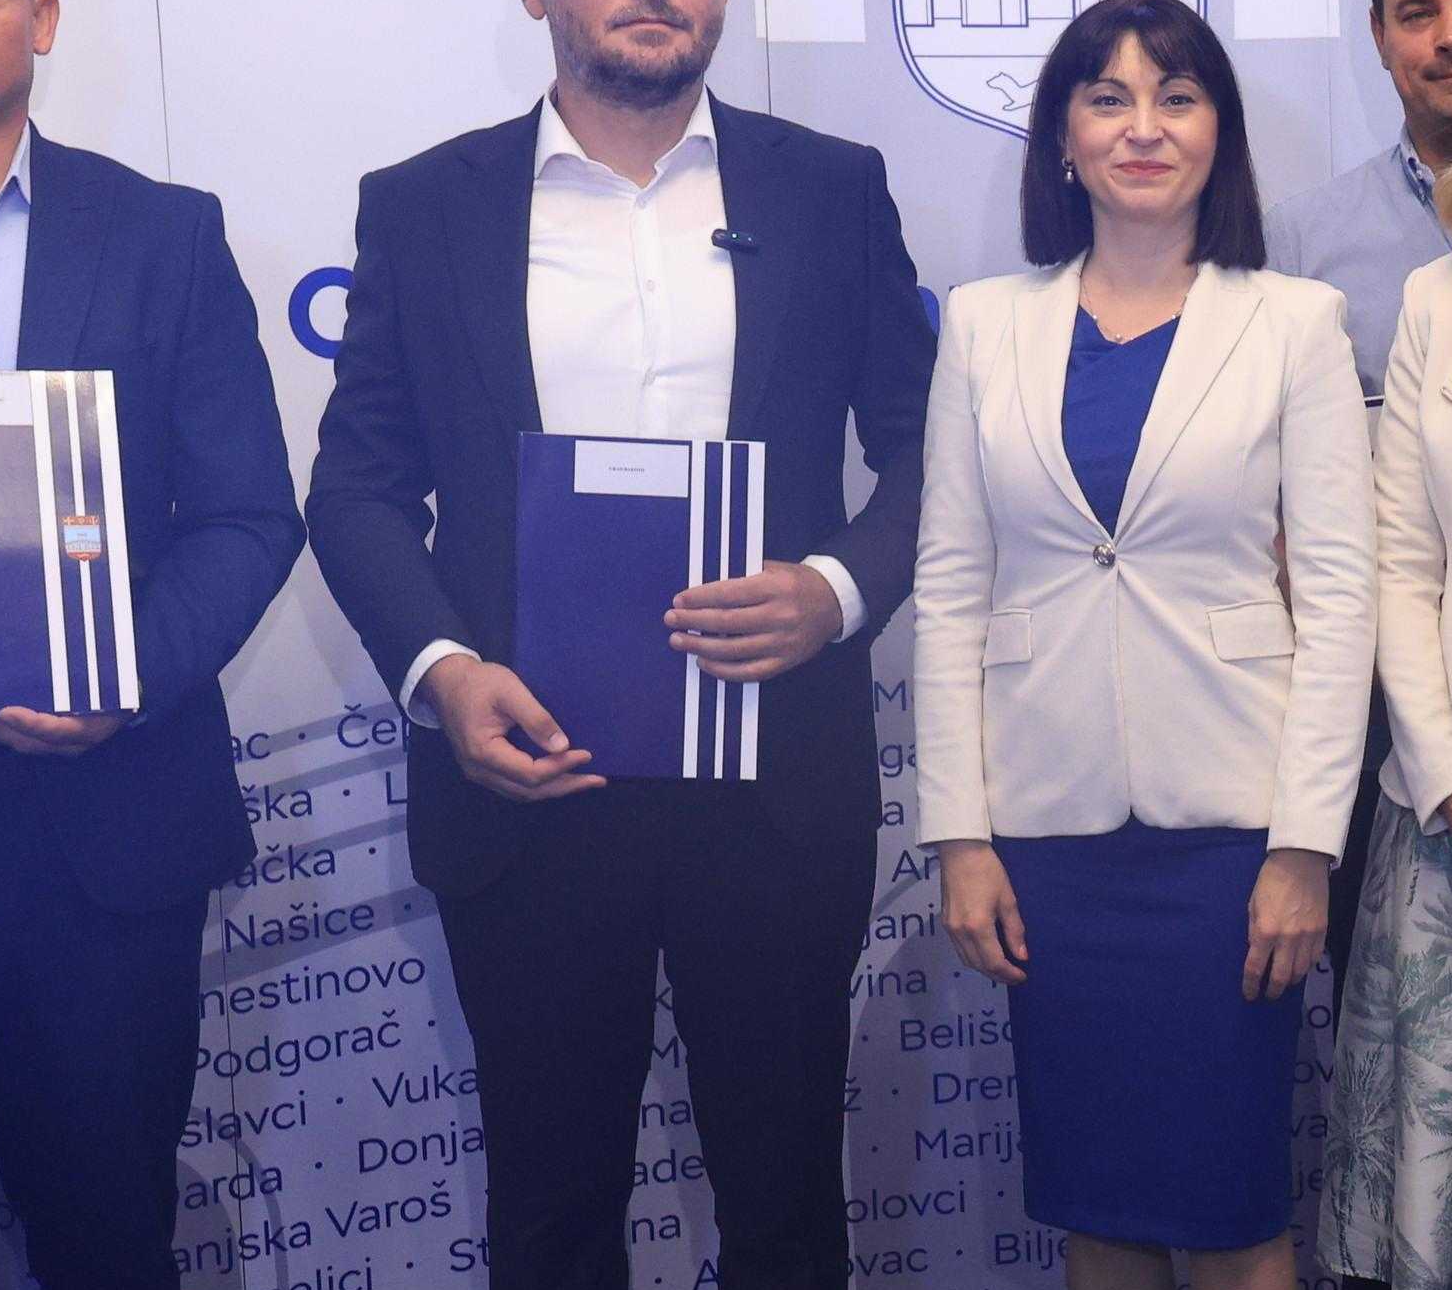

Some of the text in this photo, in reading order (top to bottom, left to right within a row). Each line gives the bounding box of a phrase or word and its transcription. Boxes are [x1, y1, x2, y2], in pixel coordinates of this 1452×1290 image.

[224, 902, 375, 953] Našice
[358, 1121, 485, 1173] Donja
[325, 1179, 452, 1237] Varoš
